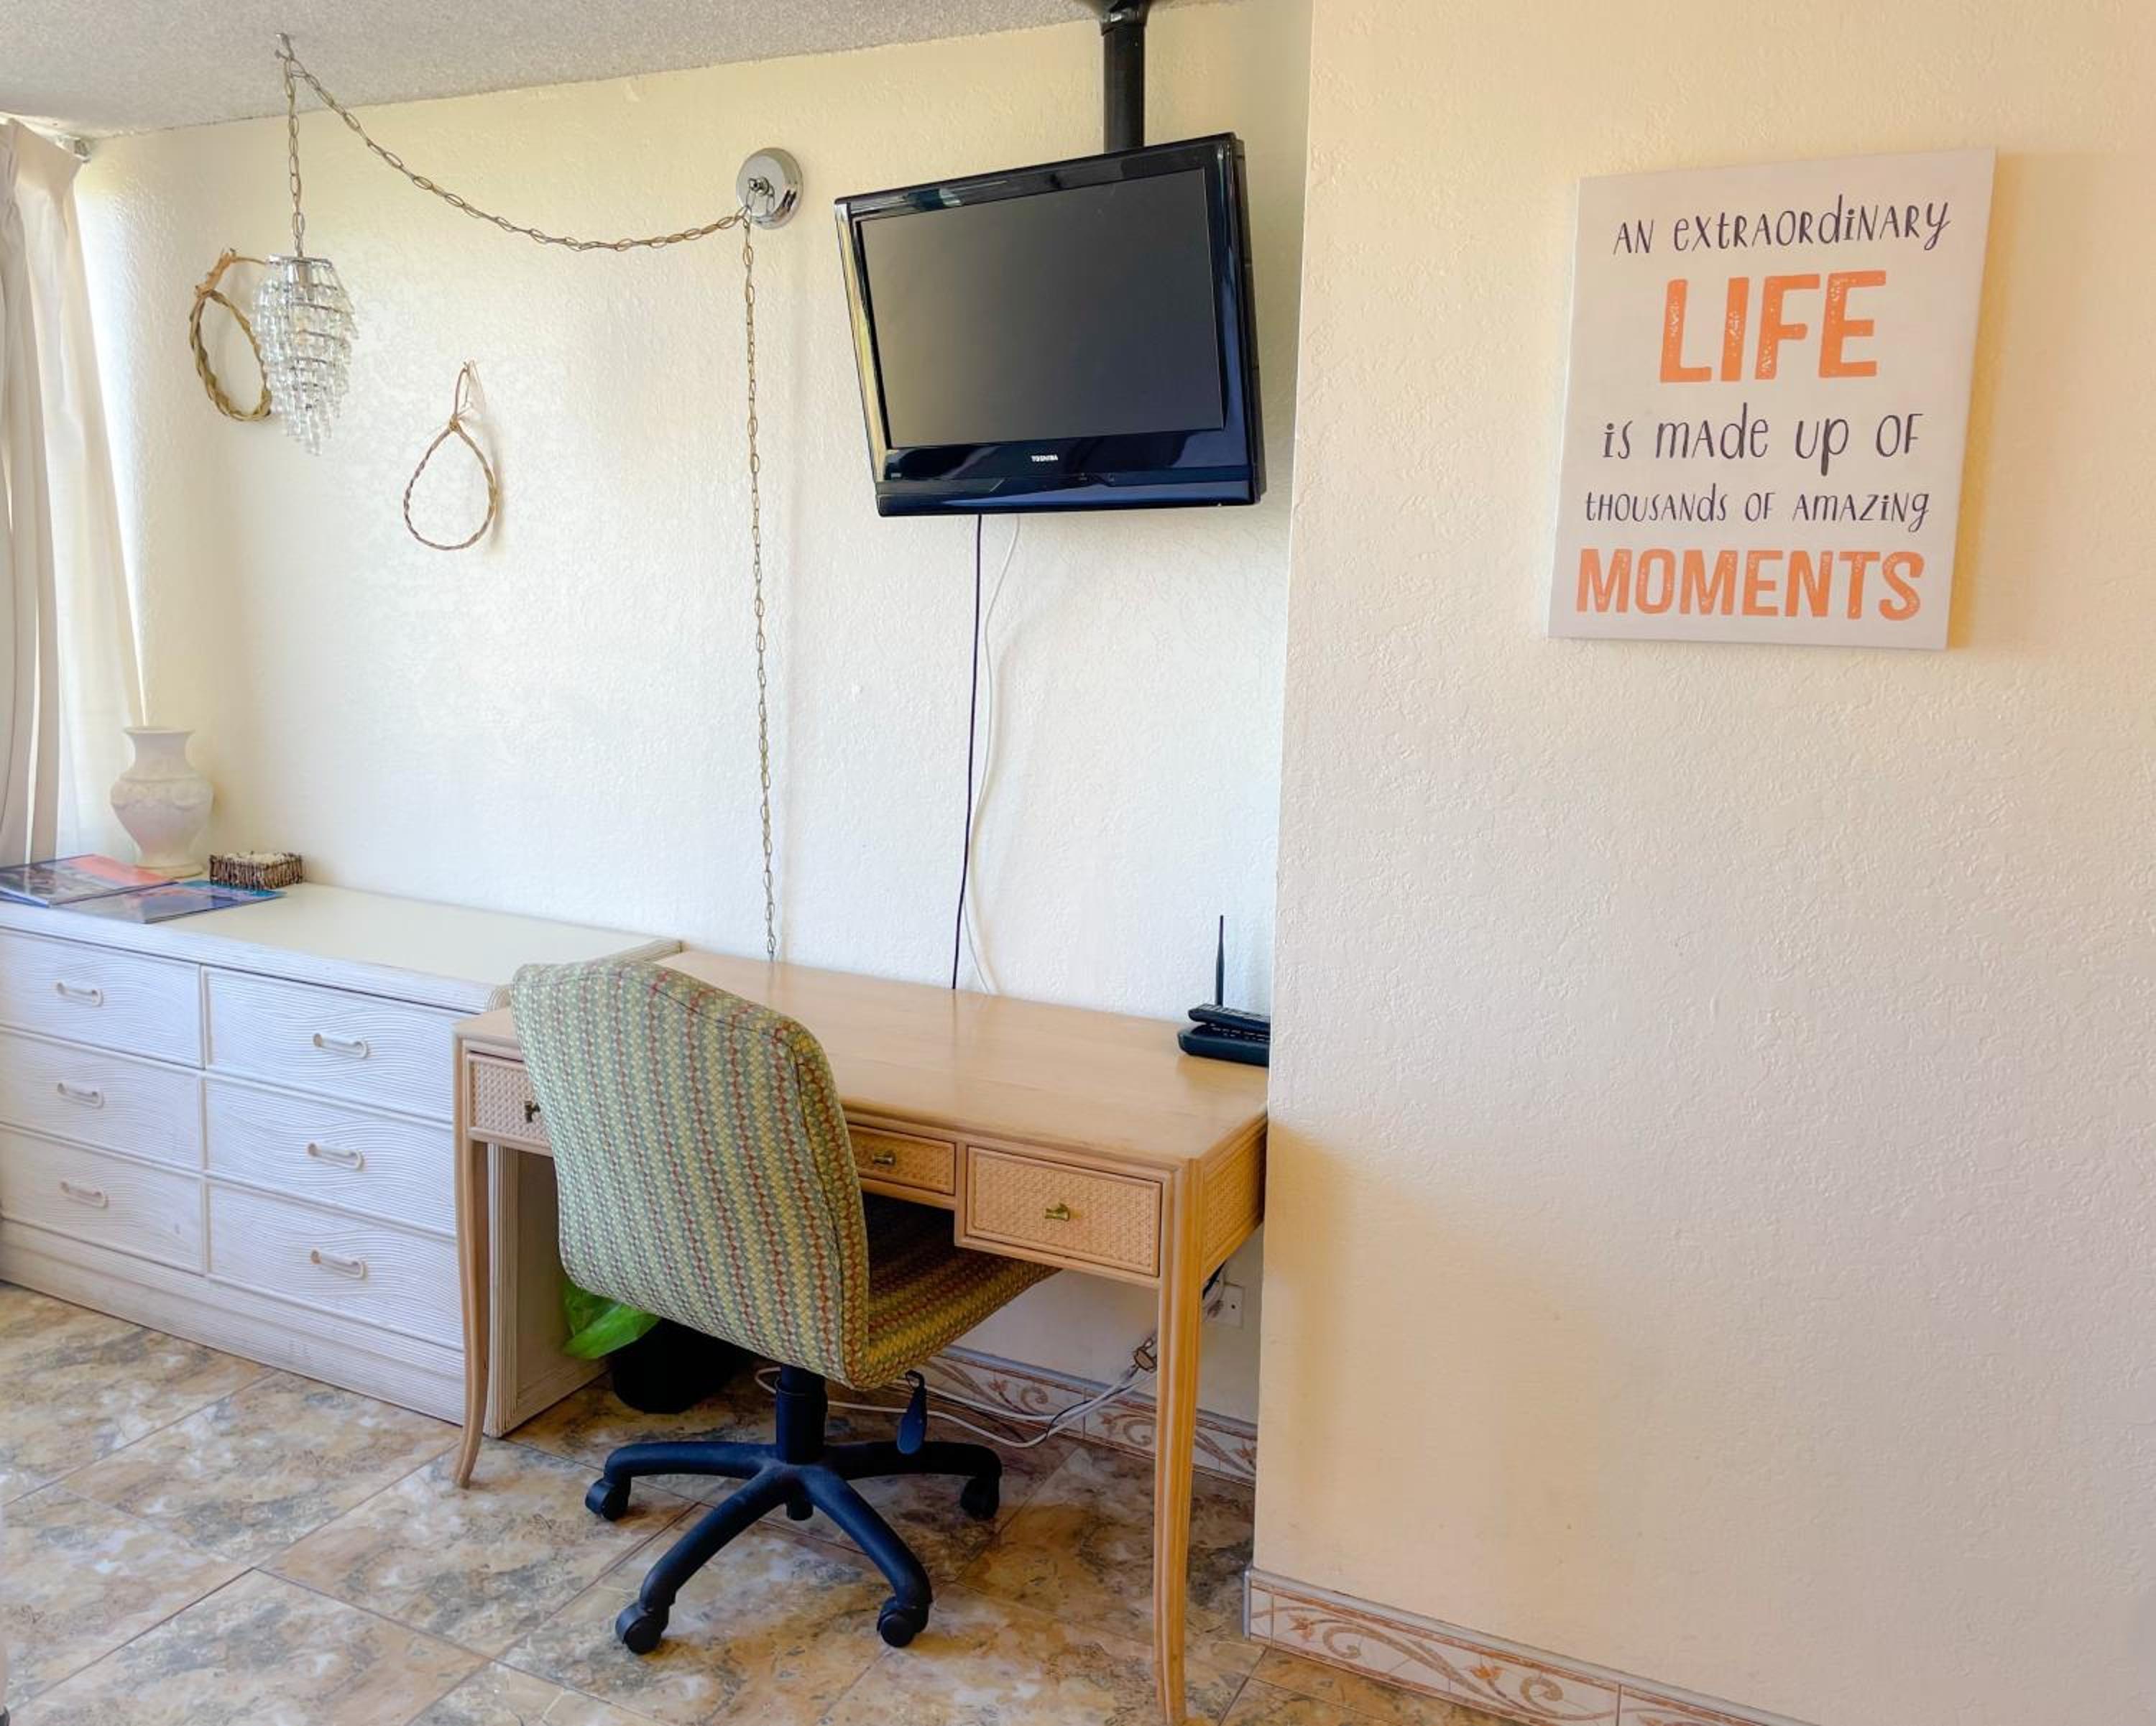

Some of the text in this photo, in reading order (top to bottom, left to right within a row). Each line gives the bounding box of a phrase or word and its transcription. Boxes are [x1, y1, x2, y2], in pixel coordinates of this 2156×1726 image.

[1613, 218, 1654, 255] AN
[1659, 269, 1886, 384] LIFE
[1603, 421, 1634, 460] is
[1795, 418, 1849, 476] up
[1875, 413, 1925, 458] OF
[1744, 492, 1776, 523] OF
[1576, 548, 1925, 621] MOMENTS
